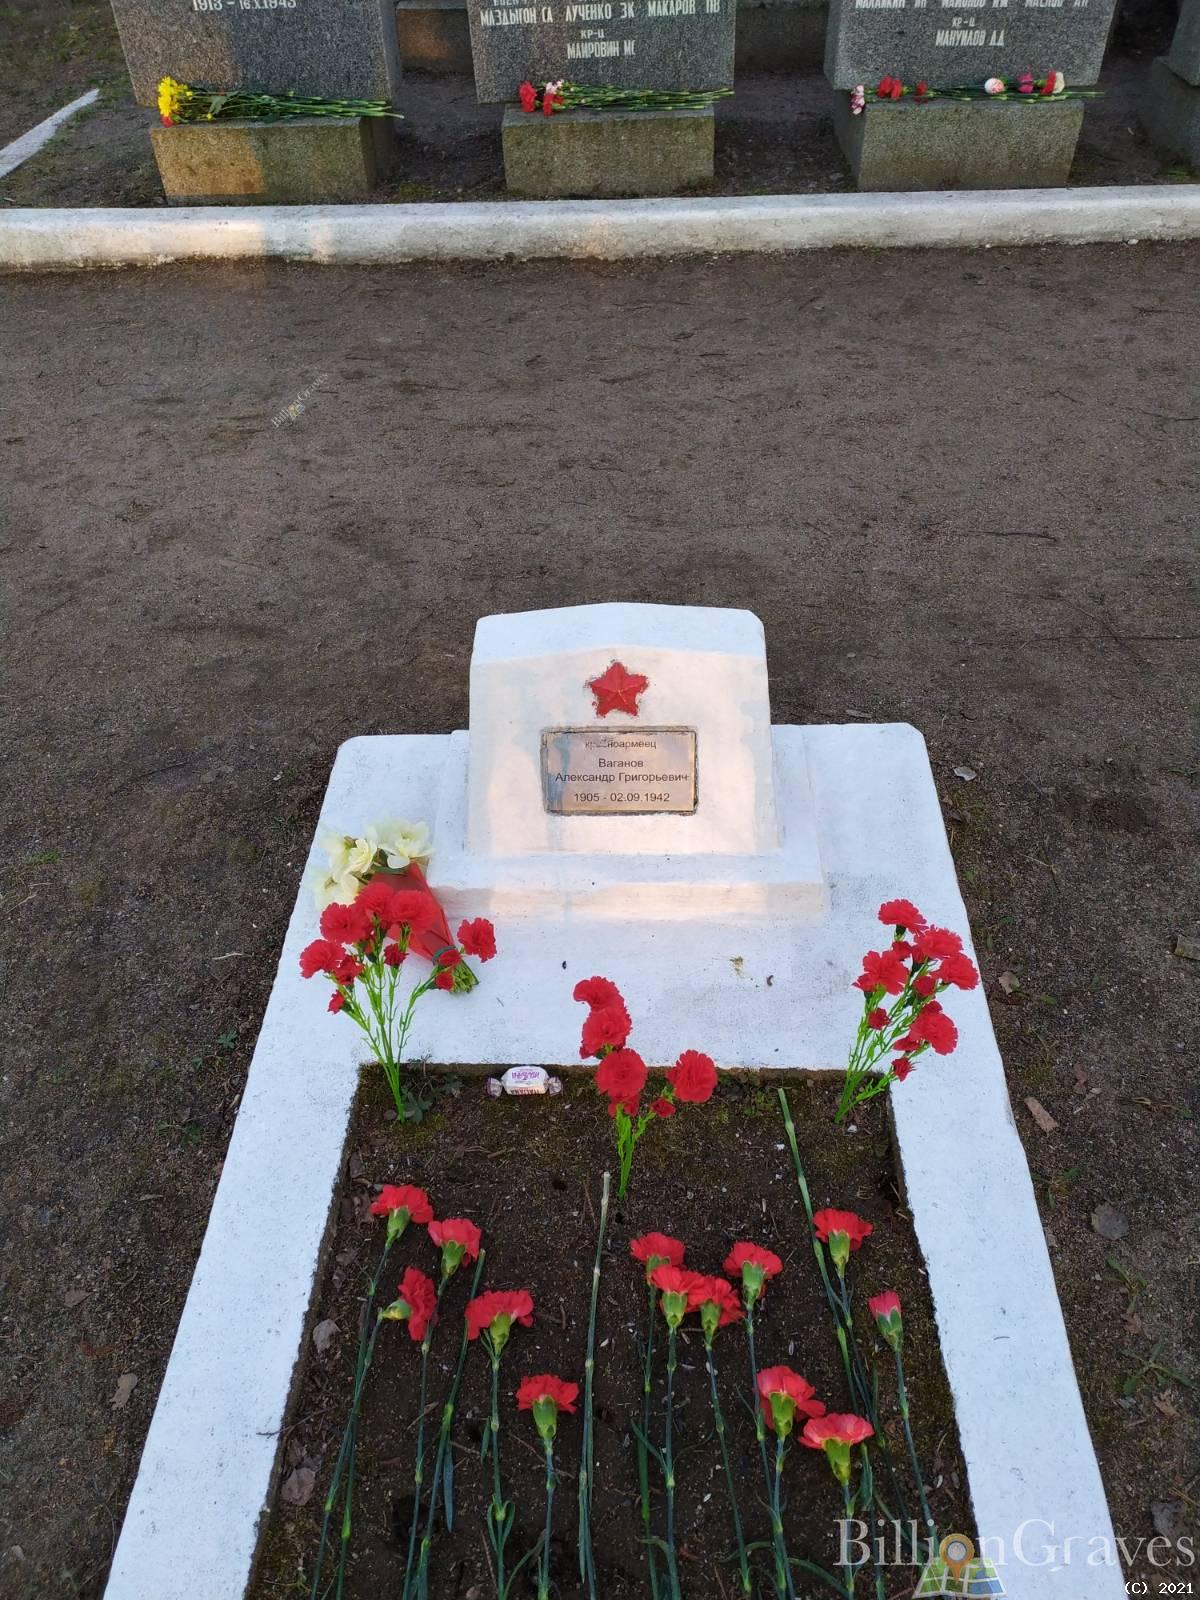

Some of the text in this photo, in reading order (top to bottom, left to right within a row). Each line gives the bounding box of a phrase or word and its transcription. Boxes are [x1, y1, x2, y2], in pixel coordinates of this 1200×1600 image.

[566, 3, 612, 22] ЛУЧЕНКО
[647, 0, 696, 17] МАКАРОВ
[598, 758, 644, 768] Ваганов
[555, 772, 689, 783] Александр Григорьевич
[575, 792, 600, 802] 1905
[610, 792, 670, 802] 02.09.1942
